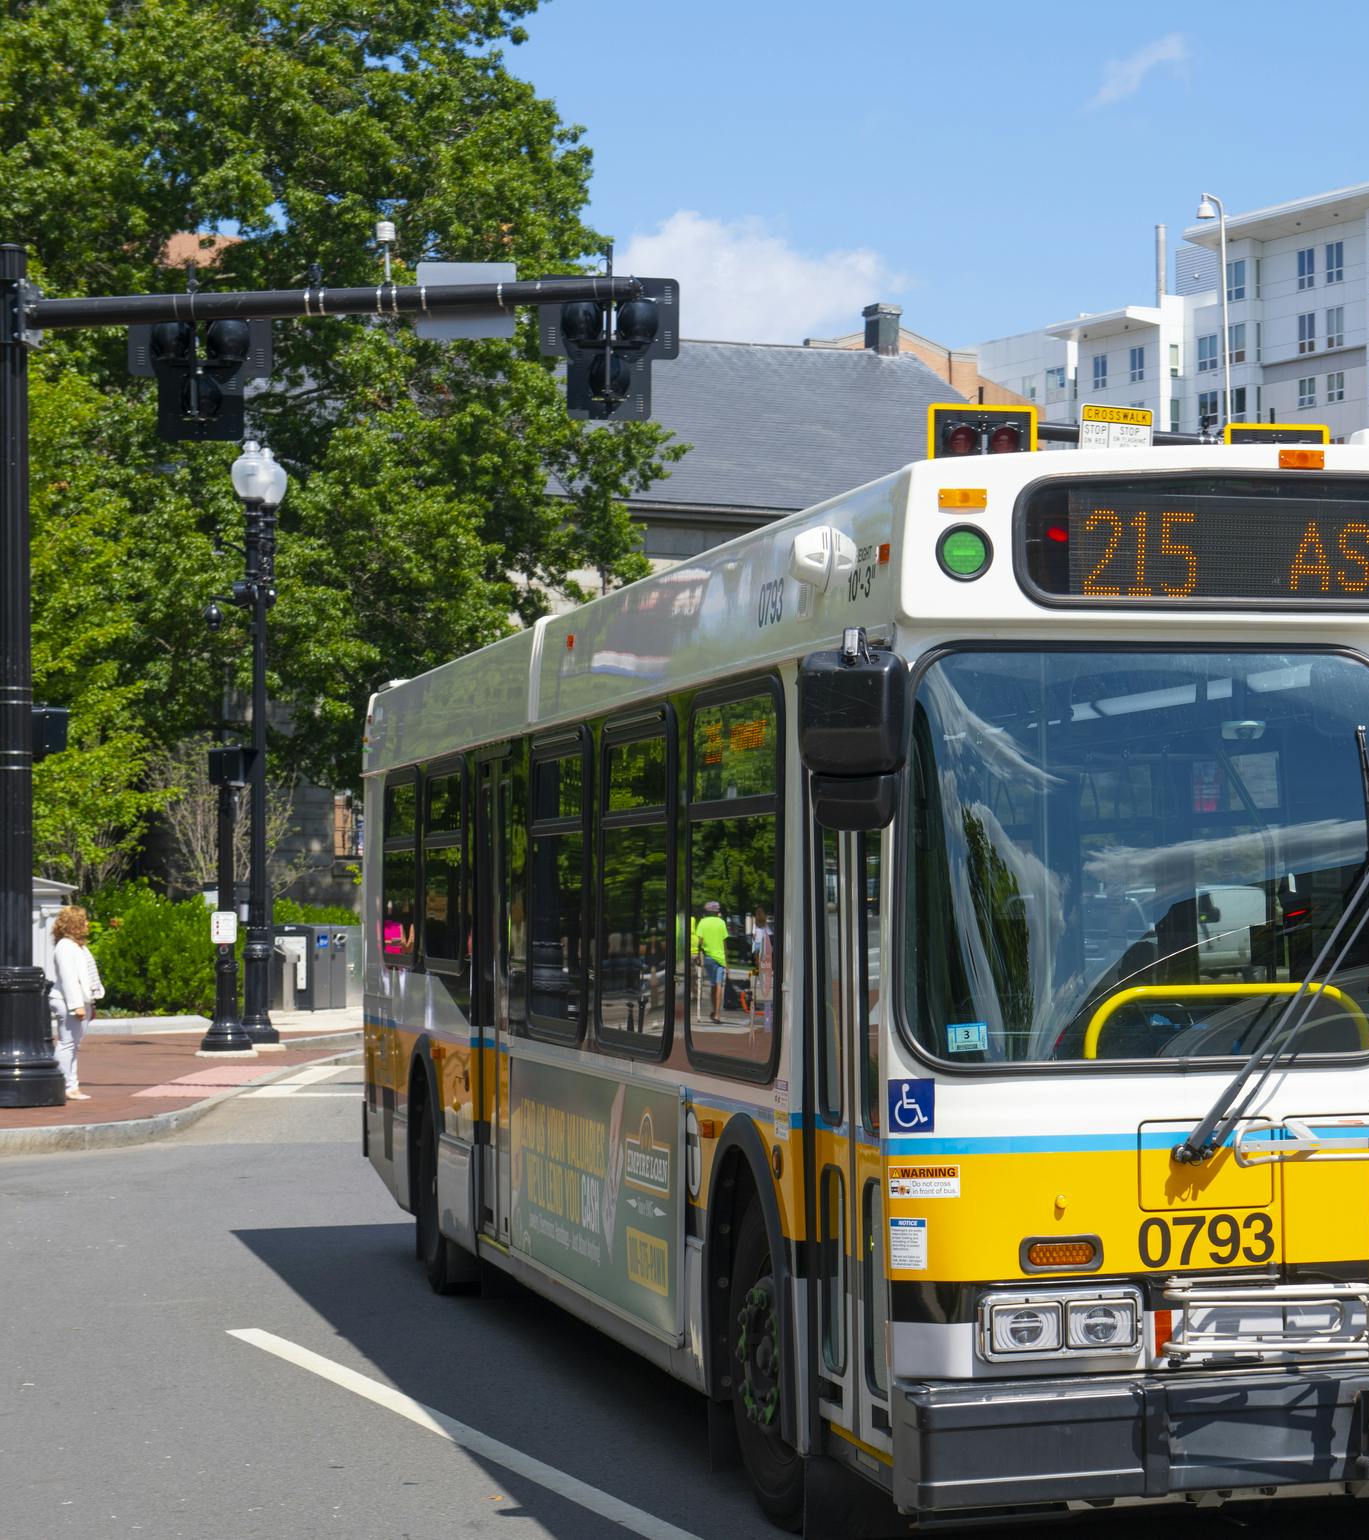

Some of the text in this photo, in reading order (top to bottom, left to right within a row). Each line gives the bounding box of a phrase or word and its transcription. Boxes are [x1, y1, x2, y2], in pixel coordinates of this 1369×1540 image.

[1087, 409, 1147, 423] CROSSWALK
[1084, 424, 1106, 434] STOP
[1120, 426, 1140, 436] STOP
[856, 545, 873, 562] EIGHT
[1082, 509, 1197, 598] 215
[758, 577, 784, 628] 0793
[964, 1030, 970, 1039] 3
[627, 1150, 668, 1184] EMPIRE LOAN
[901, 1168, 956, 1178] WARNING
[581, 1174, 600, 1234] CASH
[1138, 1212, 1275, 1268] 0793
